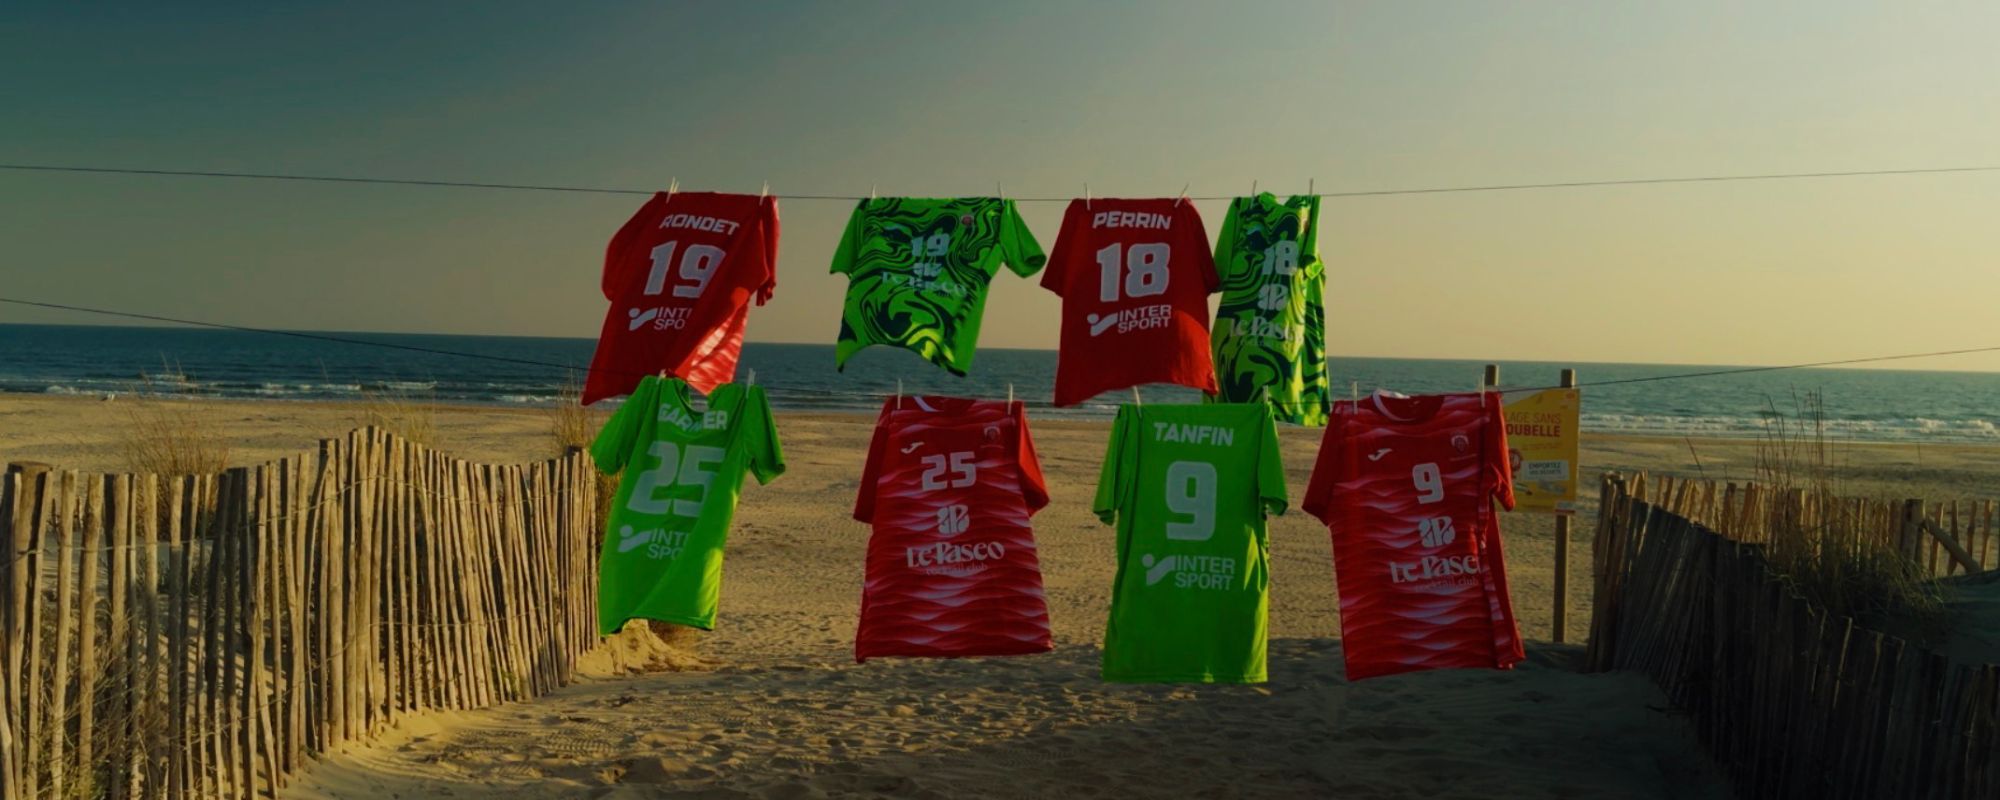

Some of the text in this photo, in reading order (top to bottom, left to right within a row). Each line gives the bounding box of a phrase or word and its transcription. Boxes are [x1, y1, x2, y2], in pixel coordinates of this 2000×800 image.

[659, 213, 740, 236] RONDET
[1092, 210, 1172, 231] PERRIN
[911, 233, 950, 257] 19
[1261, 239, 1299, 276] 18
[643, 240, 726, 299] 19
[1096, 242, 1171, 303] 18
[657, 306, 694, 319] INT
[1119, 304, 1172, 322] INTER
[653, 318, 686, 331] SPO
[1117, 315, 1172, 334] SPORT
[1505, 411, 1561, 424] LAGE SANS
[1153, 422, 1234, 447] TANFIN
[1506, 423, 1561, 437] OUBELLE
[626, 440, 727, 518] 25
[921, 451, 977, 493] 25
[1411, 462, 1445, 504] 9
[1165, 460, 1217, 541] 9
[651, 527, 689, 547] INT
[646, 543, 684, 561] SPO
[906, 541, 1006, 568] Le Pasco
[1176, 554, 1236, 575] INTER
[1420, 554, 1482, 579] Pasc
[1174, 571, 1234, 591] SPORT
[1458, 575, 1480, 587] club
